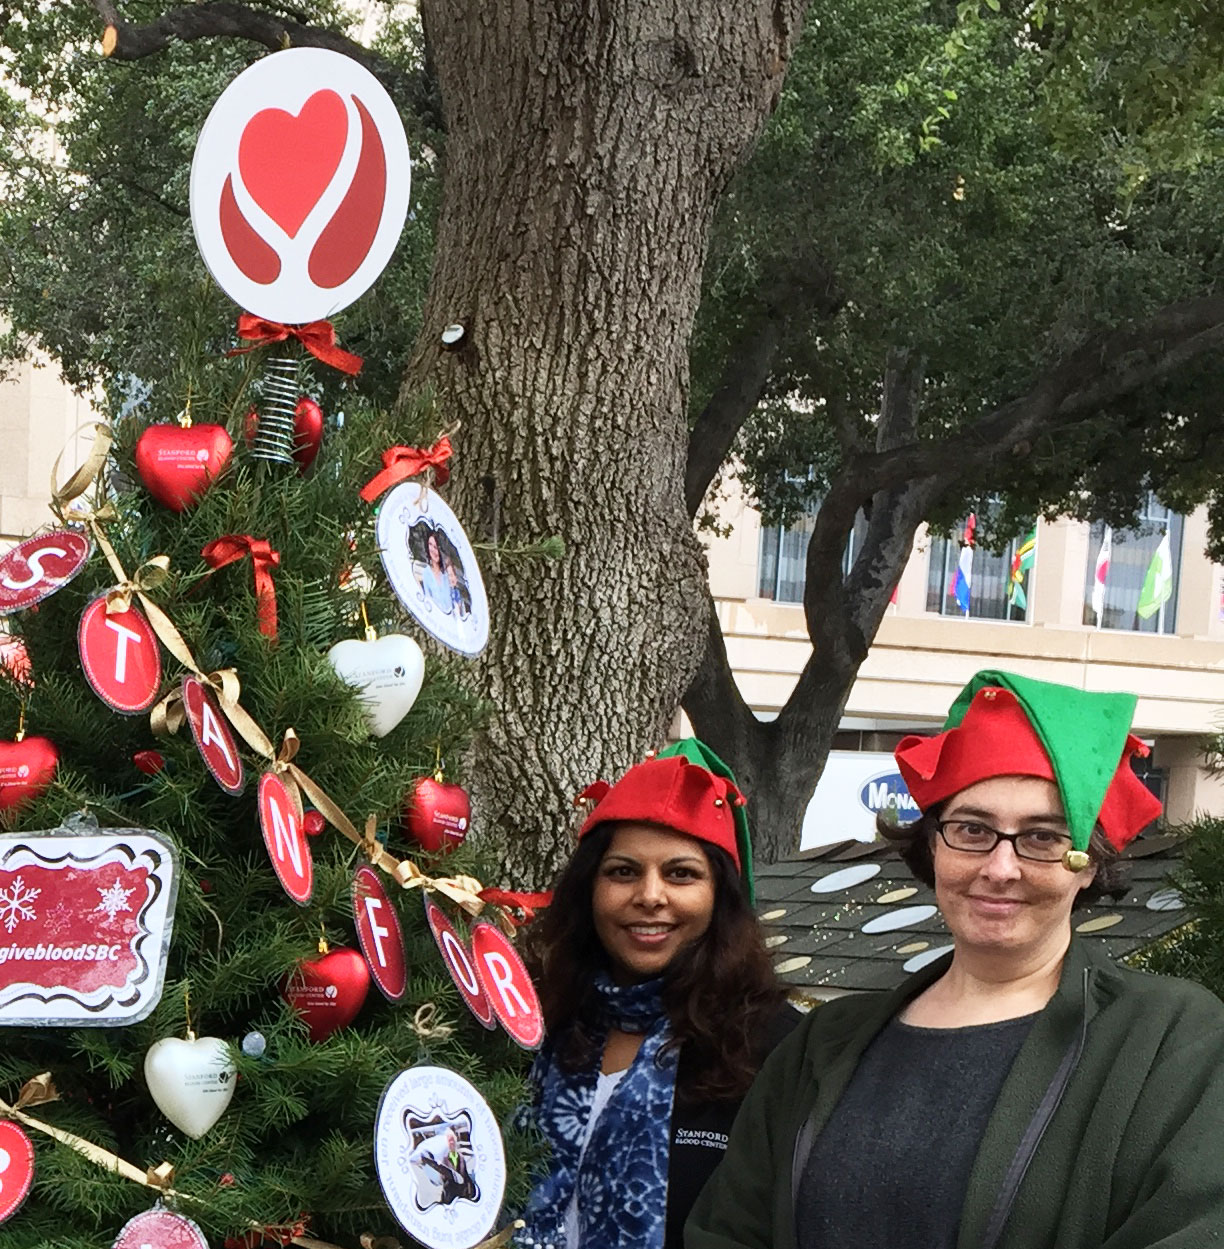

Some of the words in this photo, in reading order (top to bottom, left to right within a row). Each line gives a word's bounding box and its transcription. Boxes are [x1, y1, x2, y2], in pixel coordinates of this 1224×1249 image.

[2, 547, 67, 590] S
[105, 619, 142, 684] T
[201, 707, 236, 771] A
[269, 795, 305, 879] N
[364, 897, 390, 968] F
[441, 930, 479, 997] O
[484, 952, 531, 1018] R
[868, 782, 920, 810] MONA
[675, 1138, 700, 1146] BLOOD
[700, 1139, 728, 1150] CENTER
[676, 1127, 729, 1143] STANFORD
